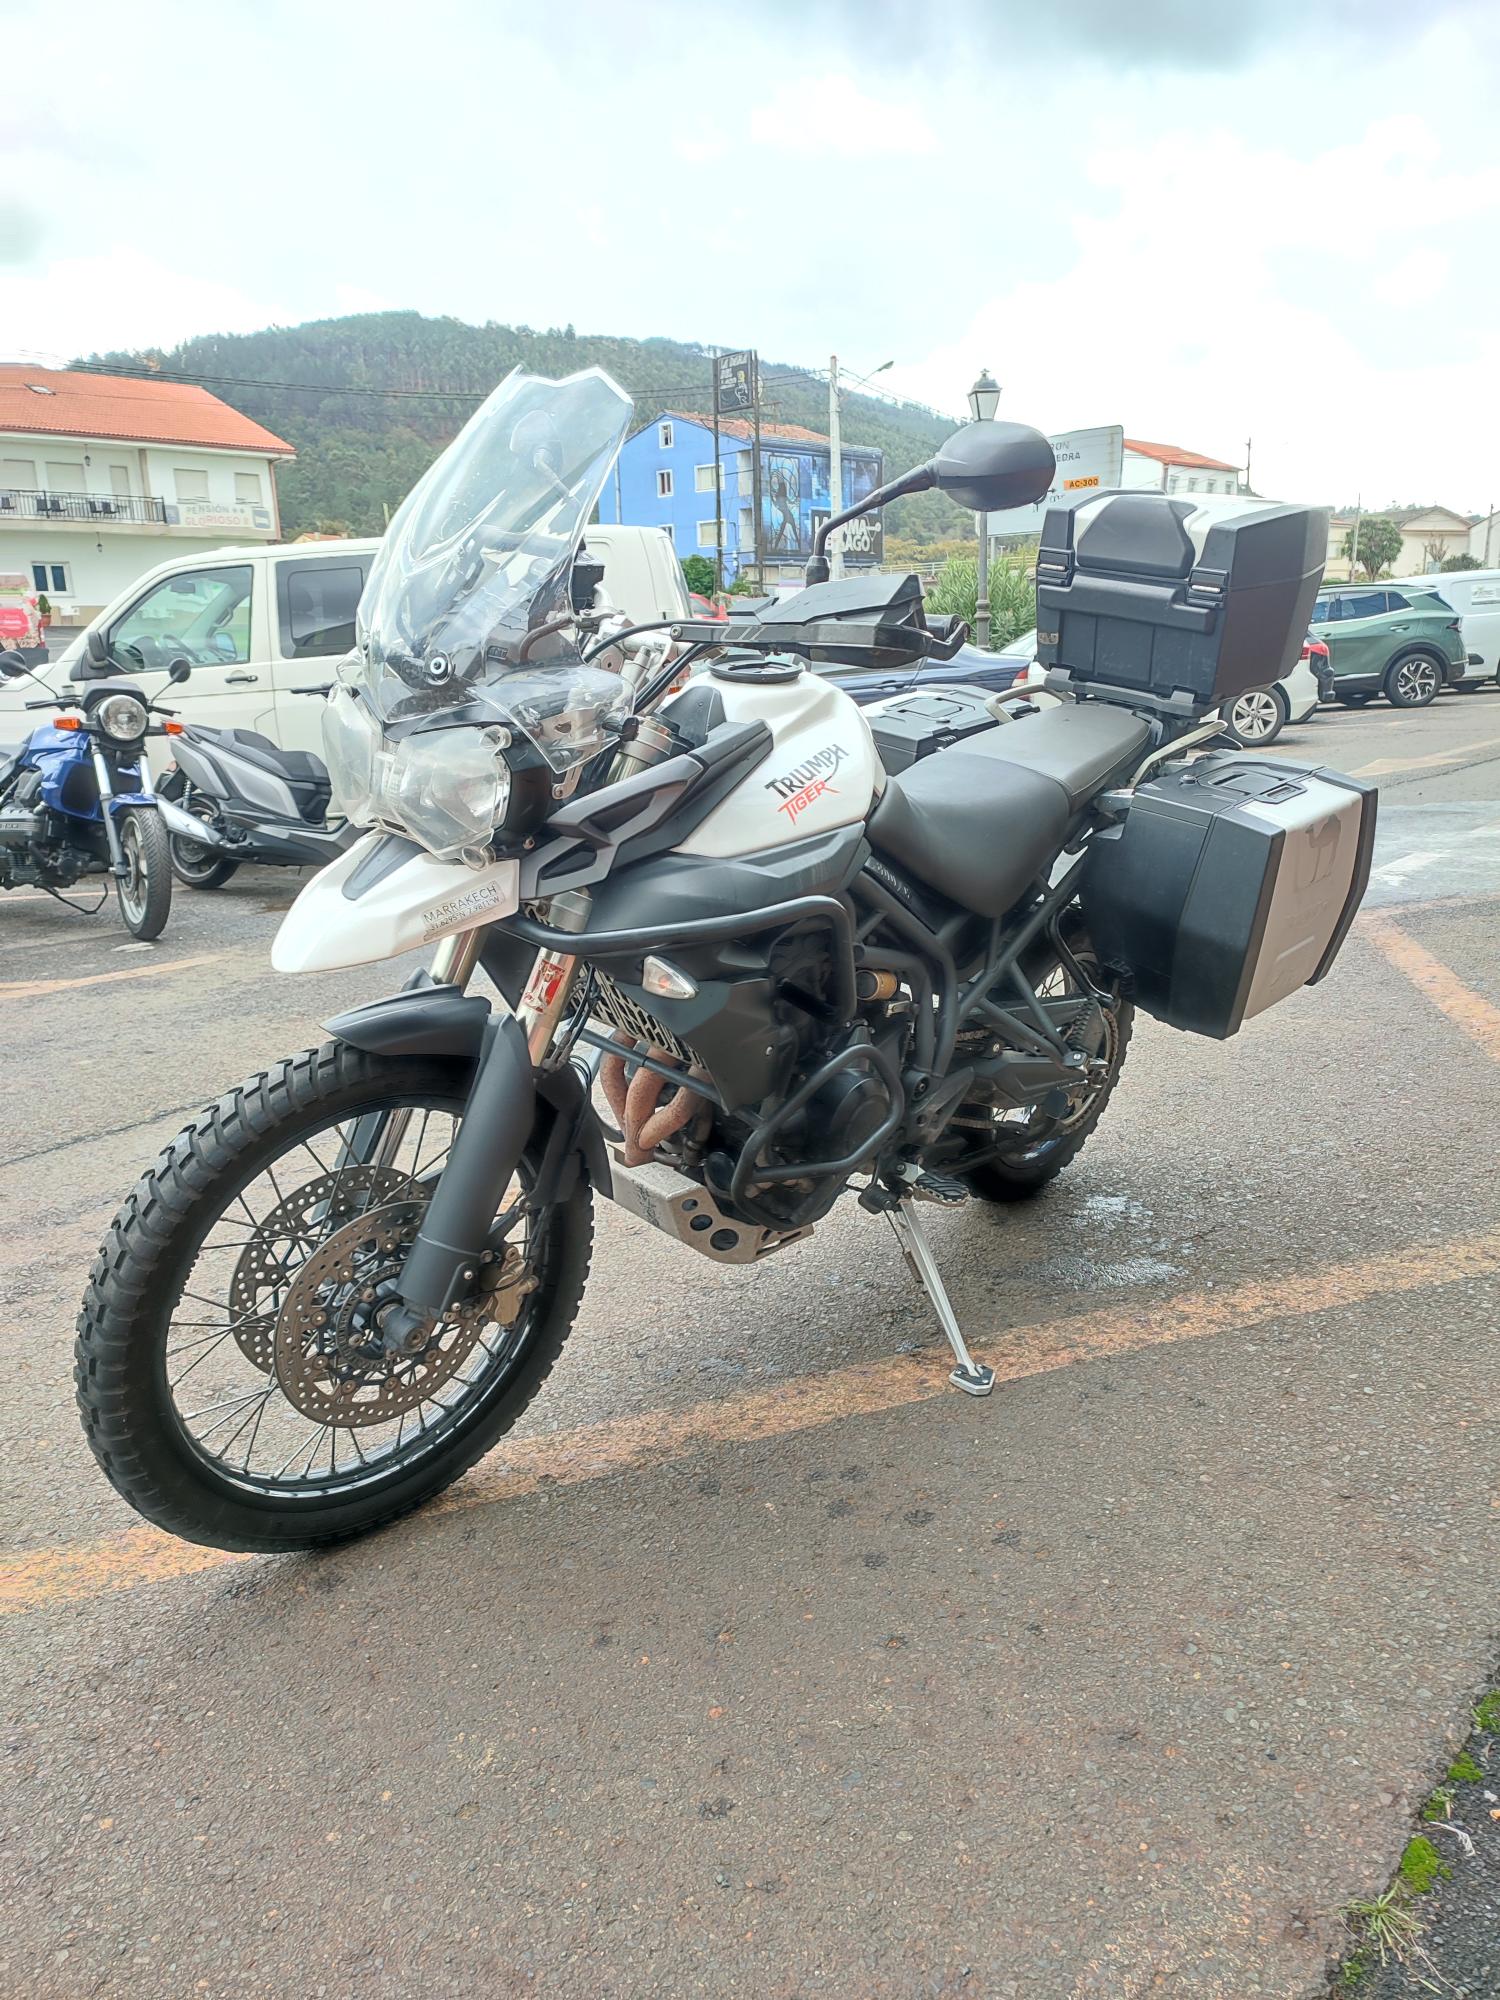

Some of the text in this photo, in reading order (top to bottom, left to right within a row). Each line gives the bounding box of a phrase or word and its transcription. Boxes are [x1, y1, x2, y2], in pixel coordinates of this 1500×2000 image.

[1056, 452, 1080, 462] EDRA
[1069, 478, 1098, 488] AC-300
[764, 744, 849, 799] TRIUMPH
[778, 780, 840, 825] TIGER
[424, 885, 497, 923] MARRAKECH
